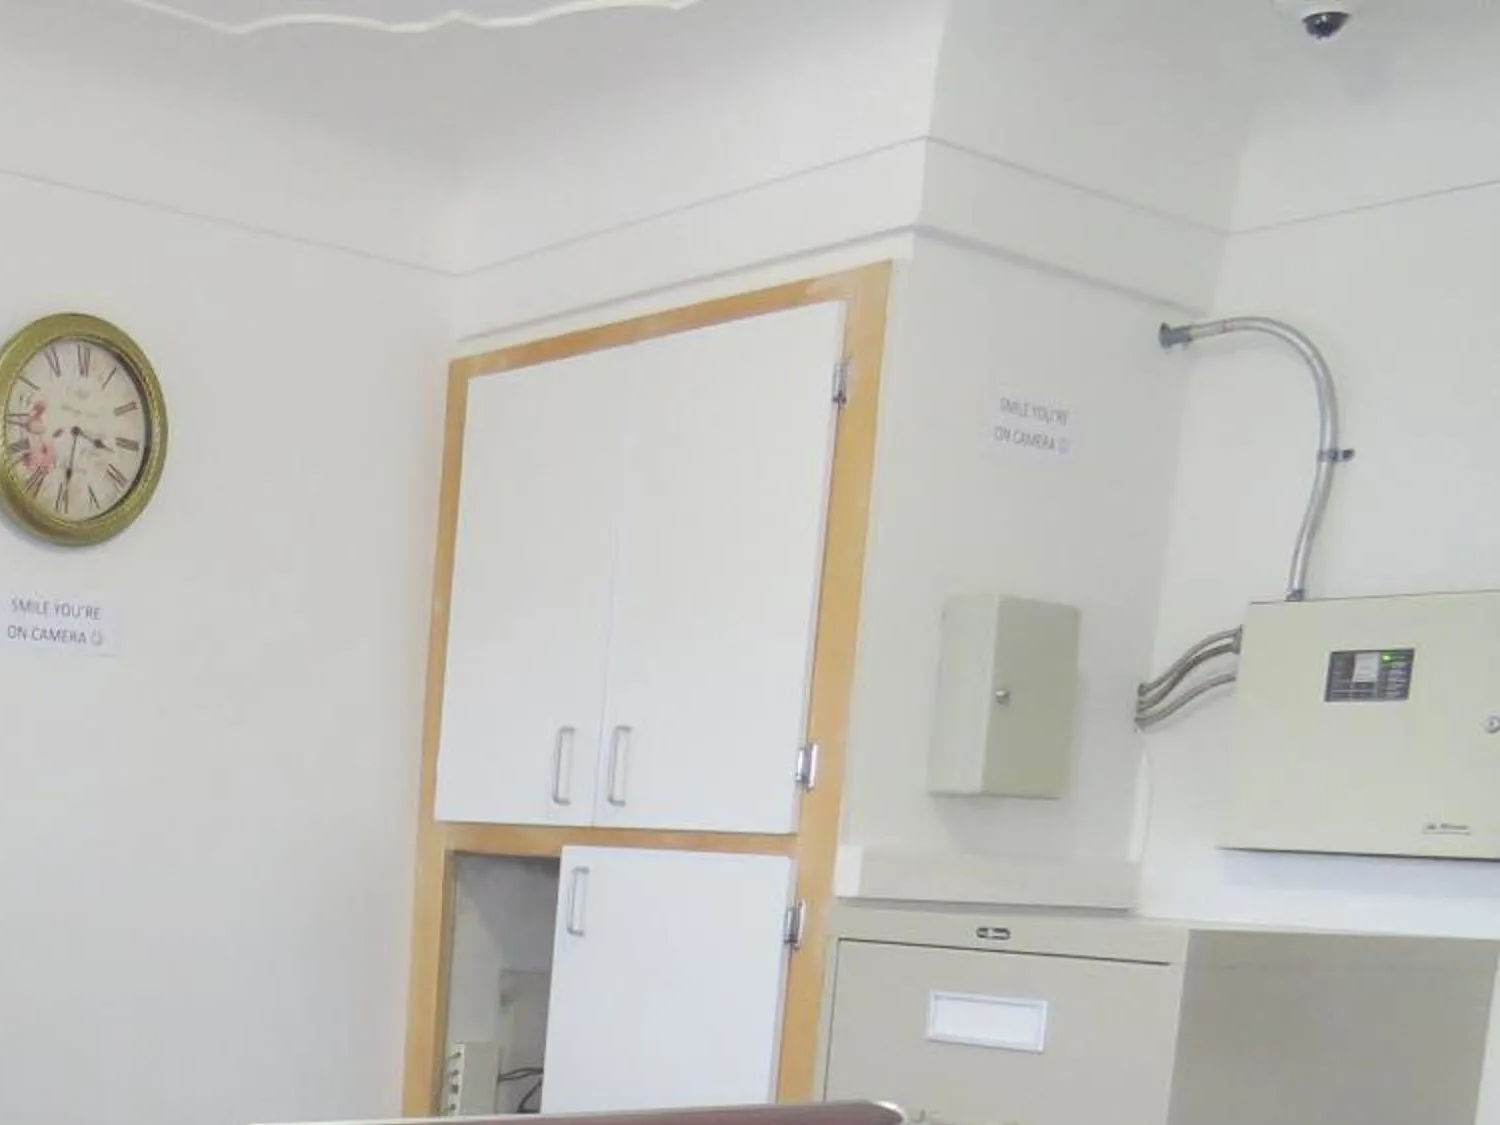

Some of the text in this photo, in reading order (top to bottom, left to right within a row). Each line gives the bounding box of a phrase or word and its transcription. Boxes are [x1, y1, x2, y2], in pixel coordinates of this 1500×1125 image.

[10, 599, 102, 620] SMILE YOU'RE
[7, 625, 88, 645] ON CAMERA
